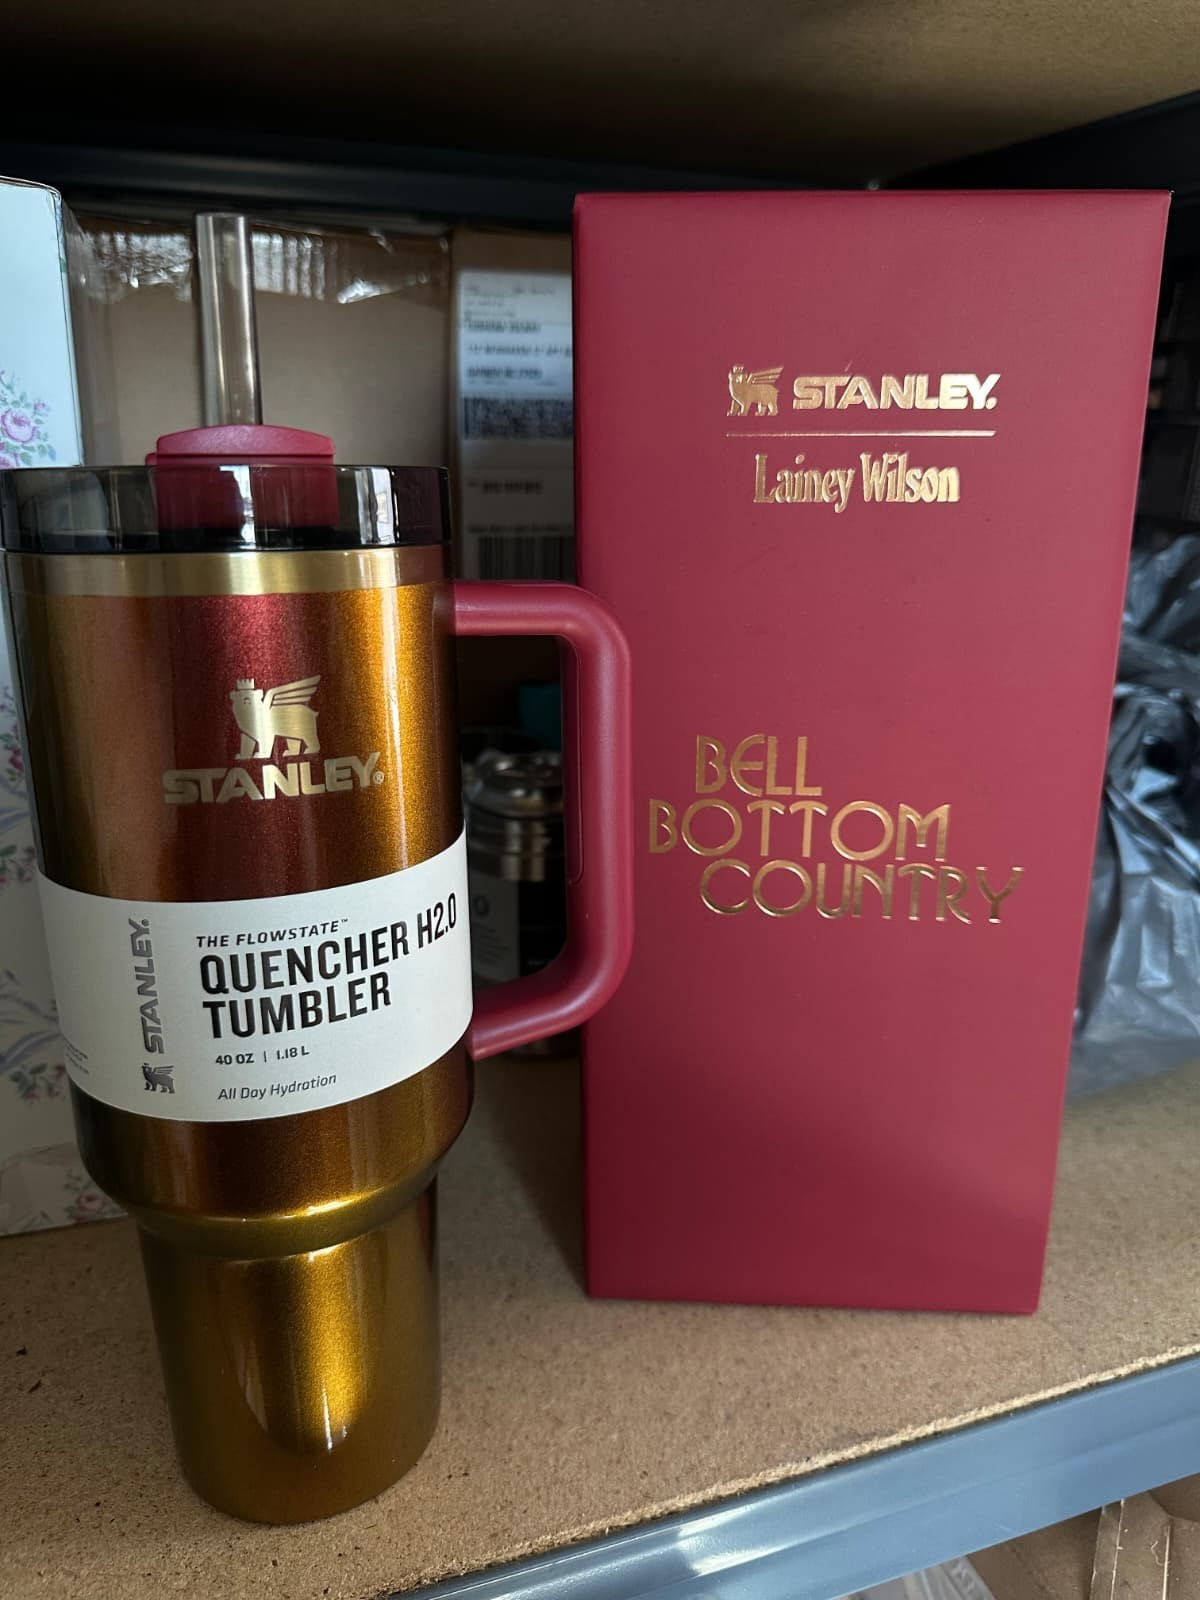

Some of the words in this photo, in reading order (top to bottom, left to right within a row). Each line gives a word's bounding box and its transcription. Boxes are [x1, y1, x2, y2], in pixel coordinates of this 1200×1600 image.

[753, 453, 855, 513] Lainey
[859, 452, 960, 502] Wilson
[695, 734, 822, 797] BELL
[649, 798, 951, 862] BOTTOM
[701, 858, 1025, 925] COUNTRY
[196, 935, 230, 948] THE
[199, 920, 410, 995] QUENCHER
[416, 892, 457, 949] H2.0
[202, 971, 391, 1039] TUMBLER
[215, 1054, 233, 1065] 40
[235, 1053, 255, 1064] OZ
[276, 1047, 298, 1060] 1.18
[301, 1045, 310, 1056] L
[217, 1088, 237, 1101] All
[240, 1085, 267, 1100] Day
[270, 1073, 337, 1098] Hydration
